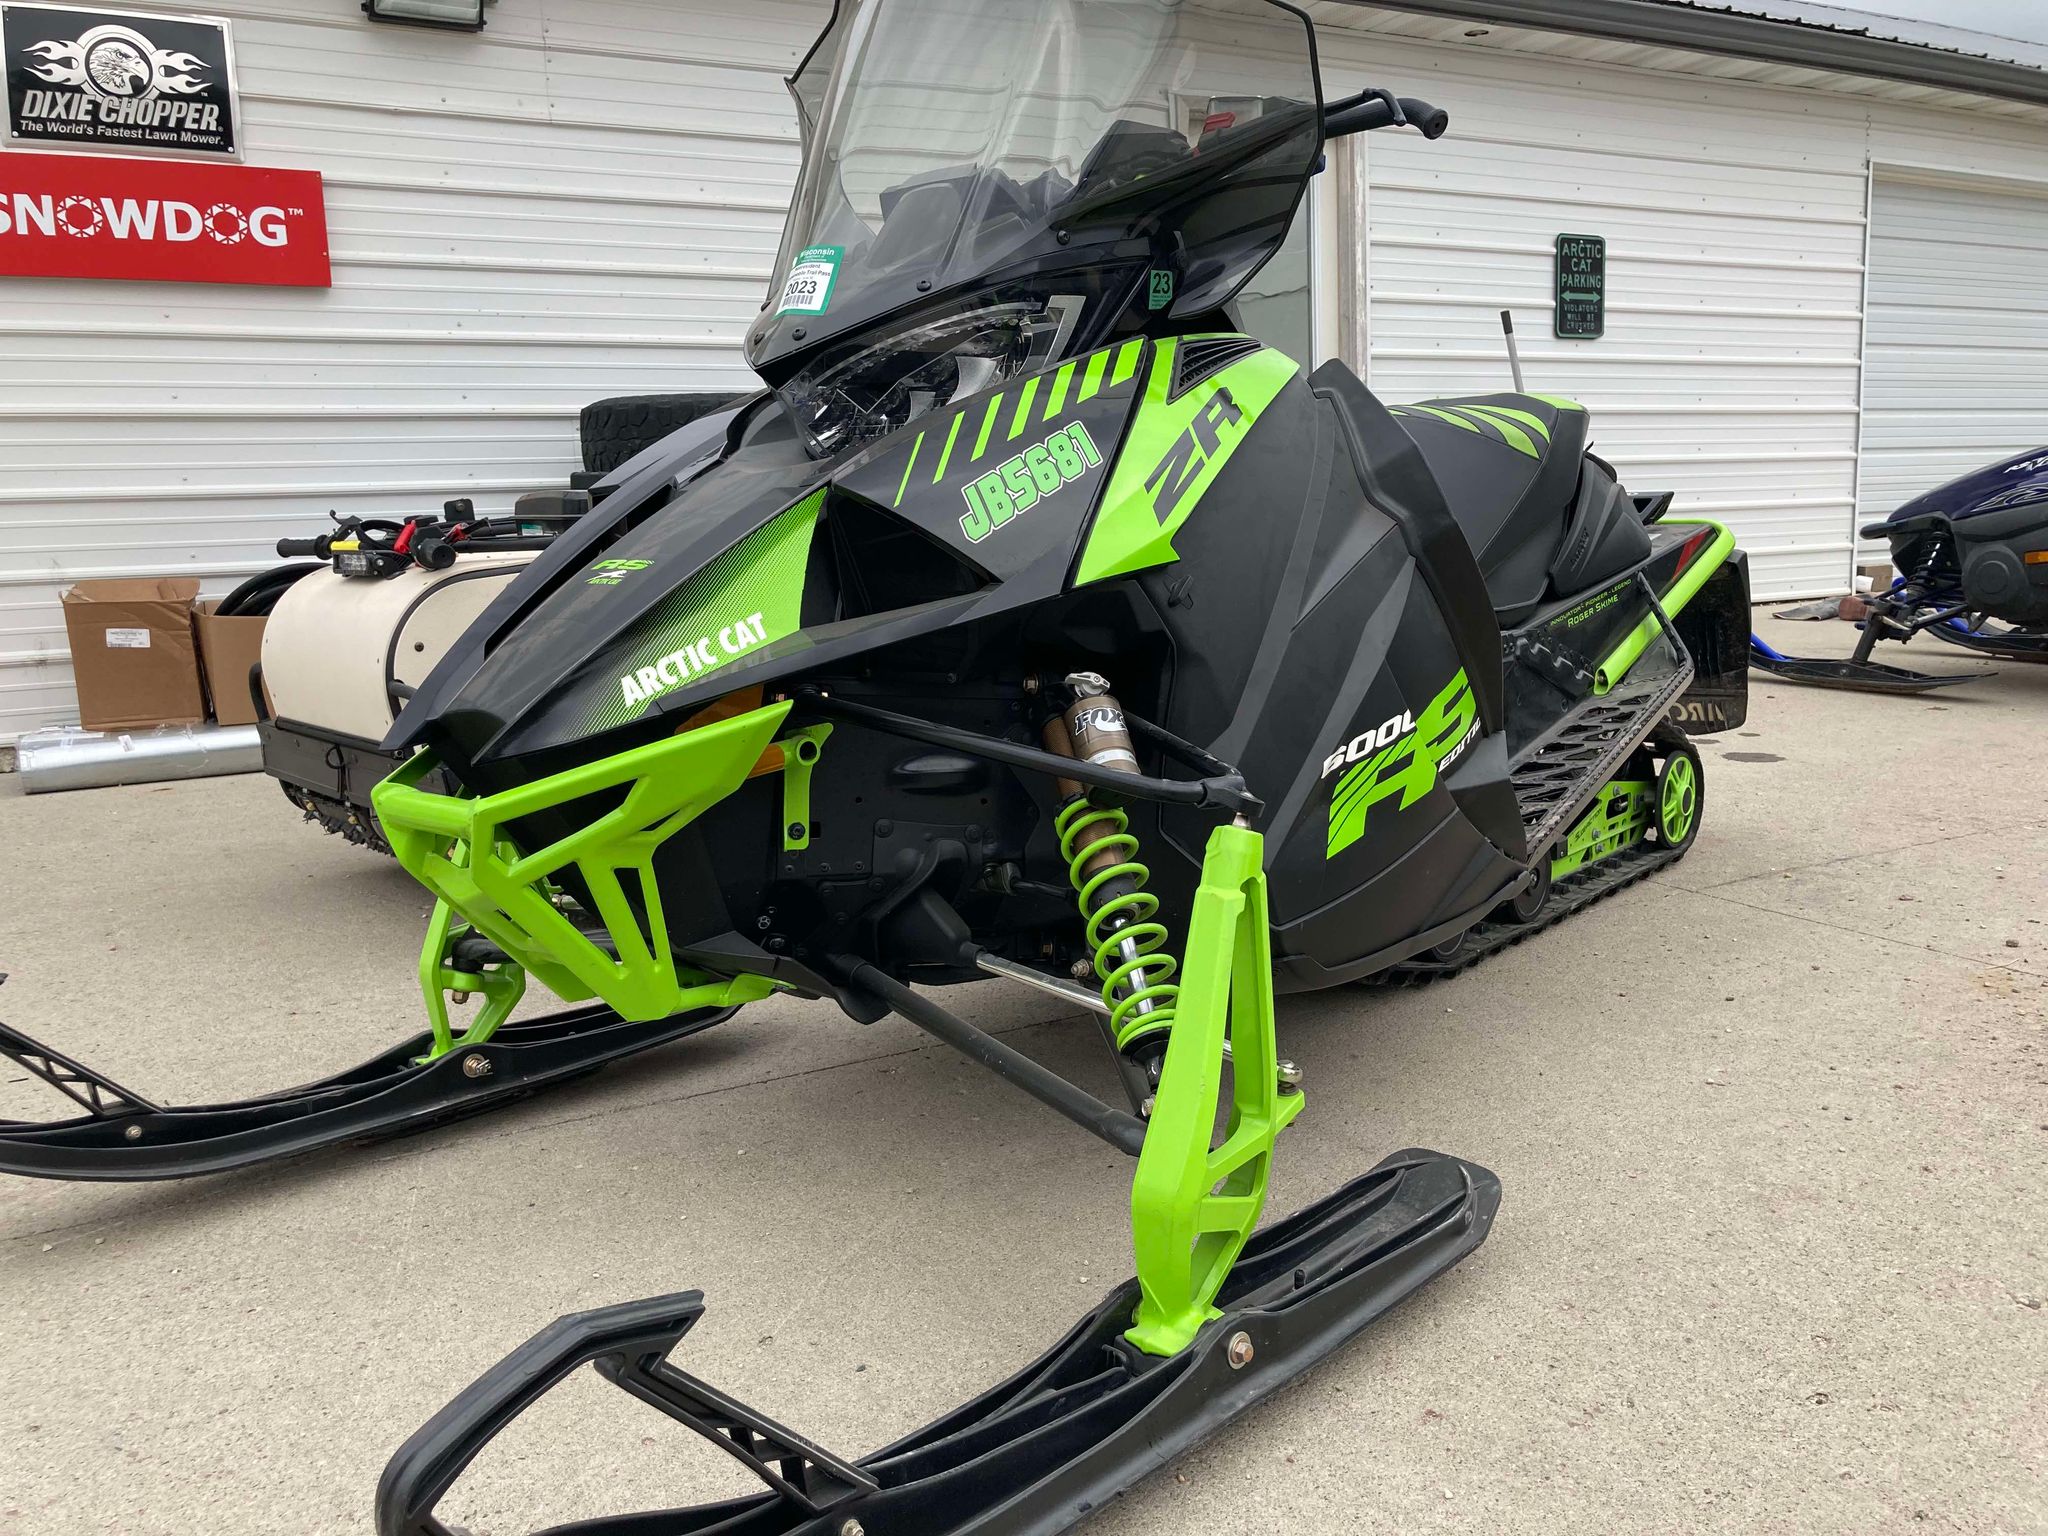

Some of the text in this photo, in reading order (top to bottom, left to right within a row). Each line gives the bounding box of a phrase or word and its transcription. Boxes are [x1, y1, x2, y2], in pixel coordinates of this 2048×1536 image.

[21, 89, 97, 121] DIXIE
[20, 120, 44, 132] The
[46, 122, 94, 135] World's
[97, 126, 142, 139] Fastest
[146, 128, 178, 141] Lawn
[1562, 243, 1602, 258] ARCTIC
[1571, 258, 1593, 272] CAT
[785, 280, 817, 297] 2023
[1152, 272, 1171, 295] 23
[1561, 273, 1602, 288] PARKING
[1564, 304, 1598, 312] VIOLATORS
[1144, 387, 1243, 527] ZR
[959, 420, 1103, 544] JB5681
[1612, 579, 1632, 593] LEGEND
[1567, 594, 1619, 627] ROGER SKIME
[620, 612, 768, 708] ARCTIC CAT
[1075, 707, 1127, 735] FOX
[1321, 708, 1417, 779] 600L
